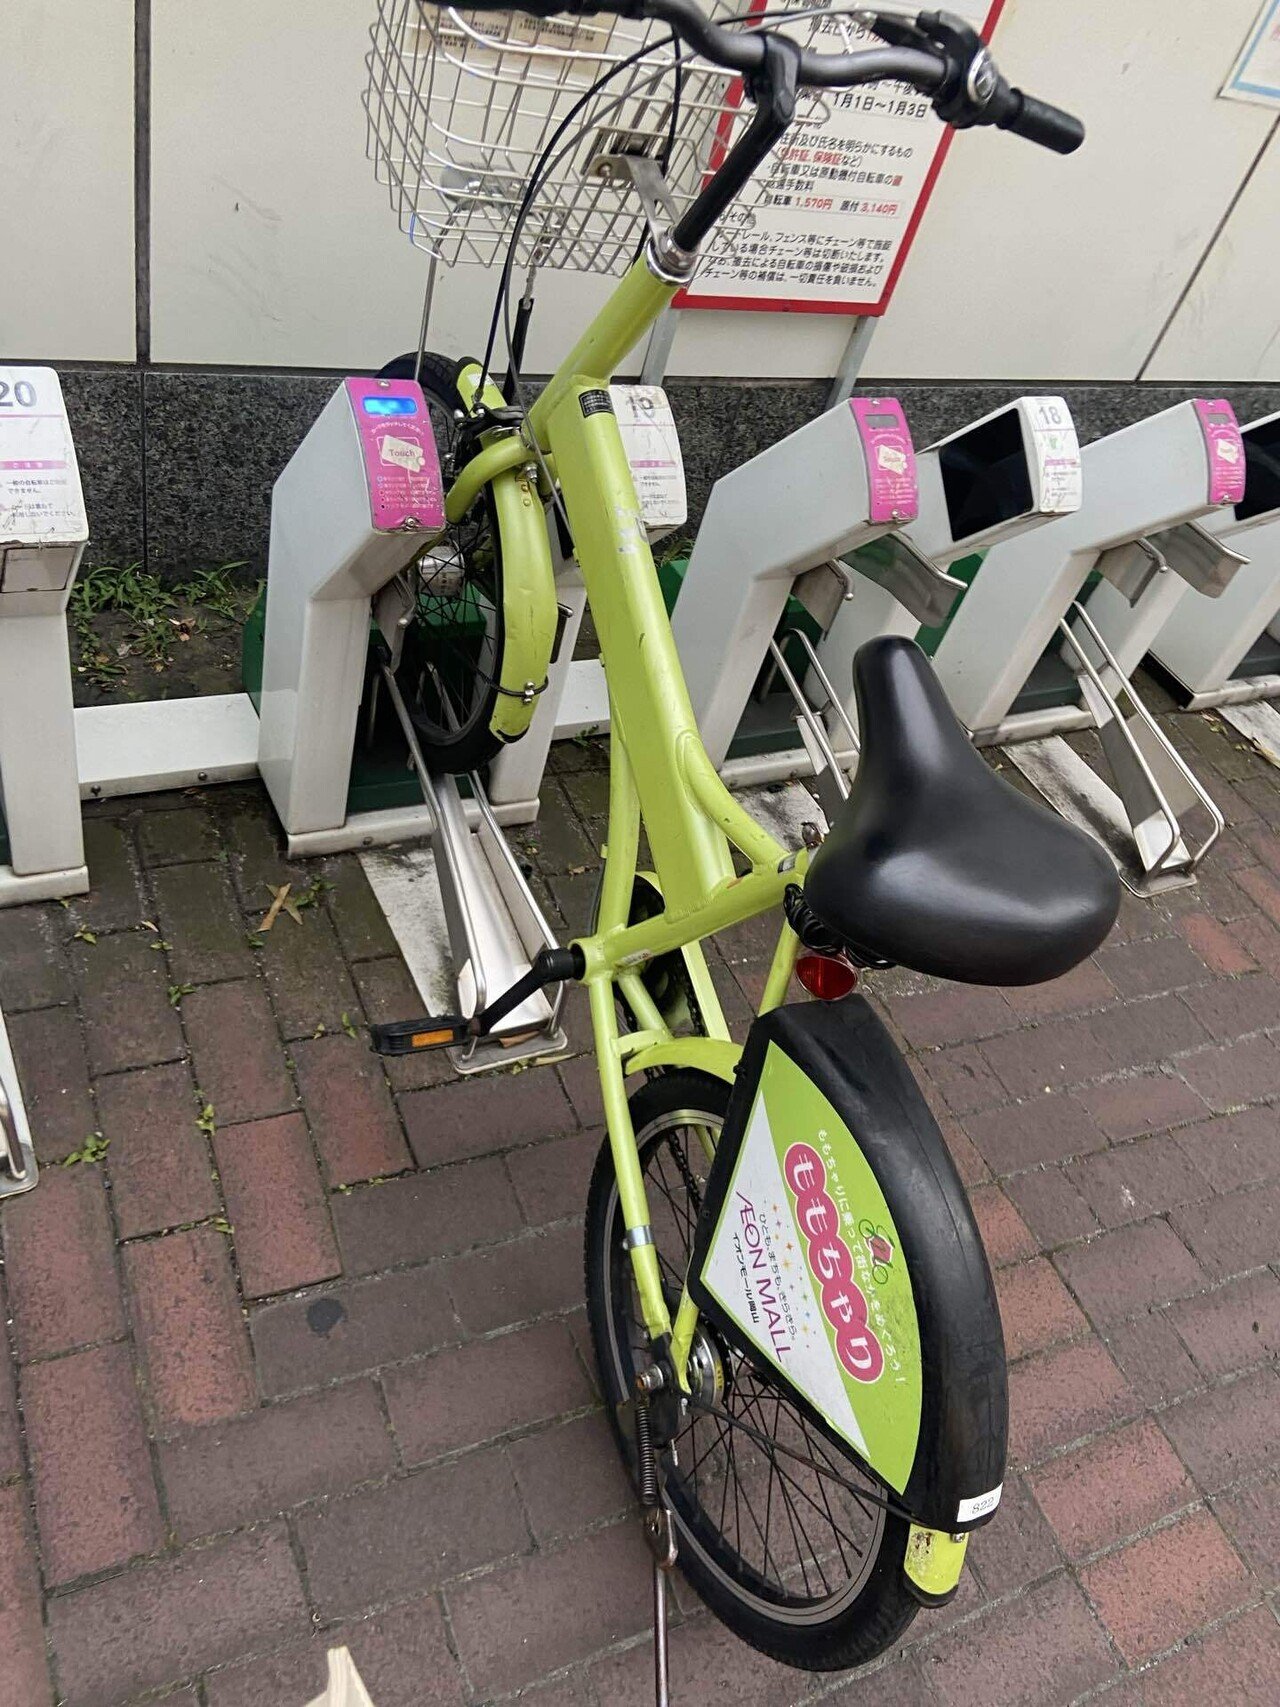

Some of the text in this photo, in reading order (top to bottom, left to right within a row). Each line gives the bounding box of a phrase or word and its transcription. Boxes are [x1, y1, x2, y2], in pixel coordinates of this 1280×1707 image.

[388, 448, 416, 458] Touch
[1038, 405, 1062, 426] 18
[732, 1231, 761, 1325] イオンモール岡山
[758, 1212, 797, 1341] ひとも、まちも、きらきら。
[792, 1153, 875, 1371] ももちゃり
[757, 1279, 792, 1363] MALL
